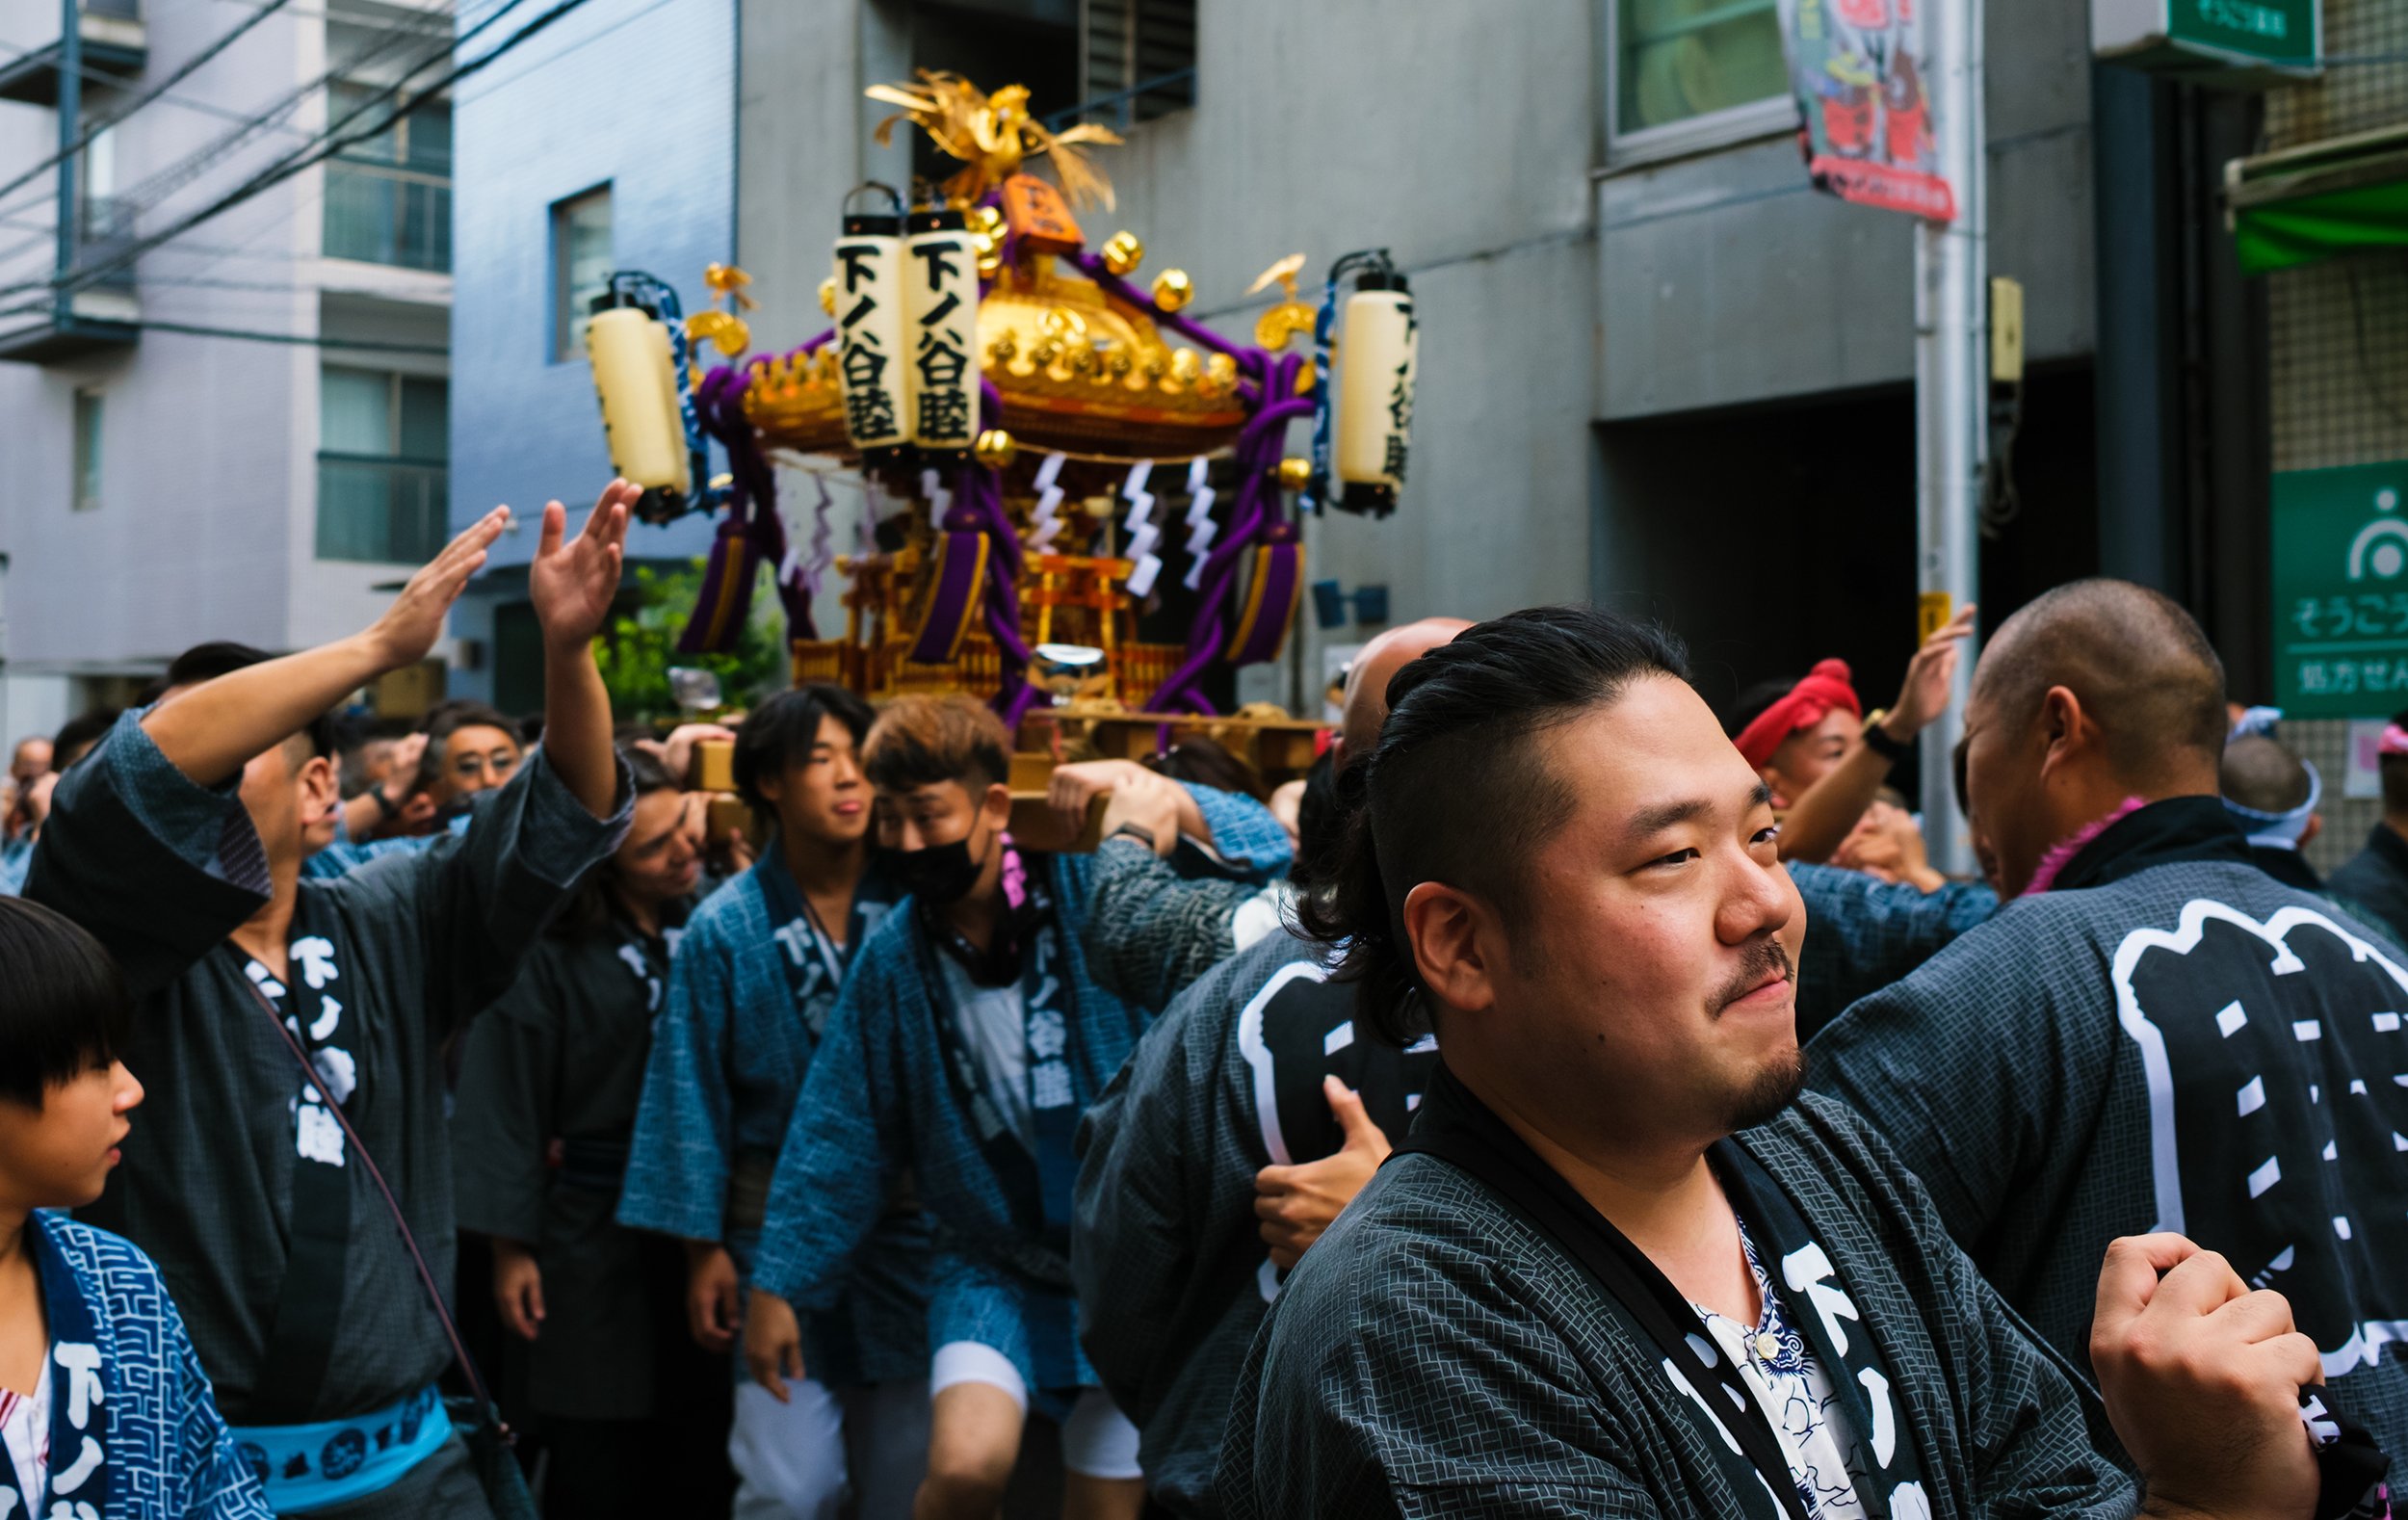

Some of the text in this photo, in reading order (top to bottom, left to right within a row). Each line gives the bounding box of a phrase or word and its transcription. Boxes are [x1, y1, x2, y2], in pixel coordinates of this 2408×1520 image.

[836, 244, 898, 439] 下ノ谷睦
[911, 241, 968, 440] 下ノ谷睦
